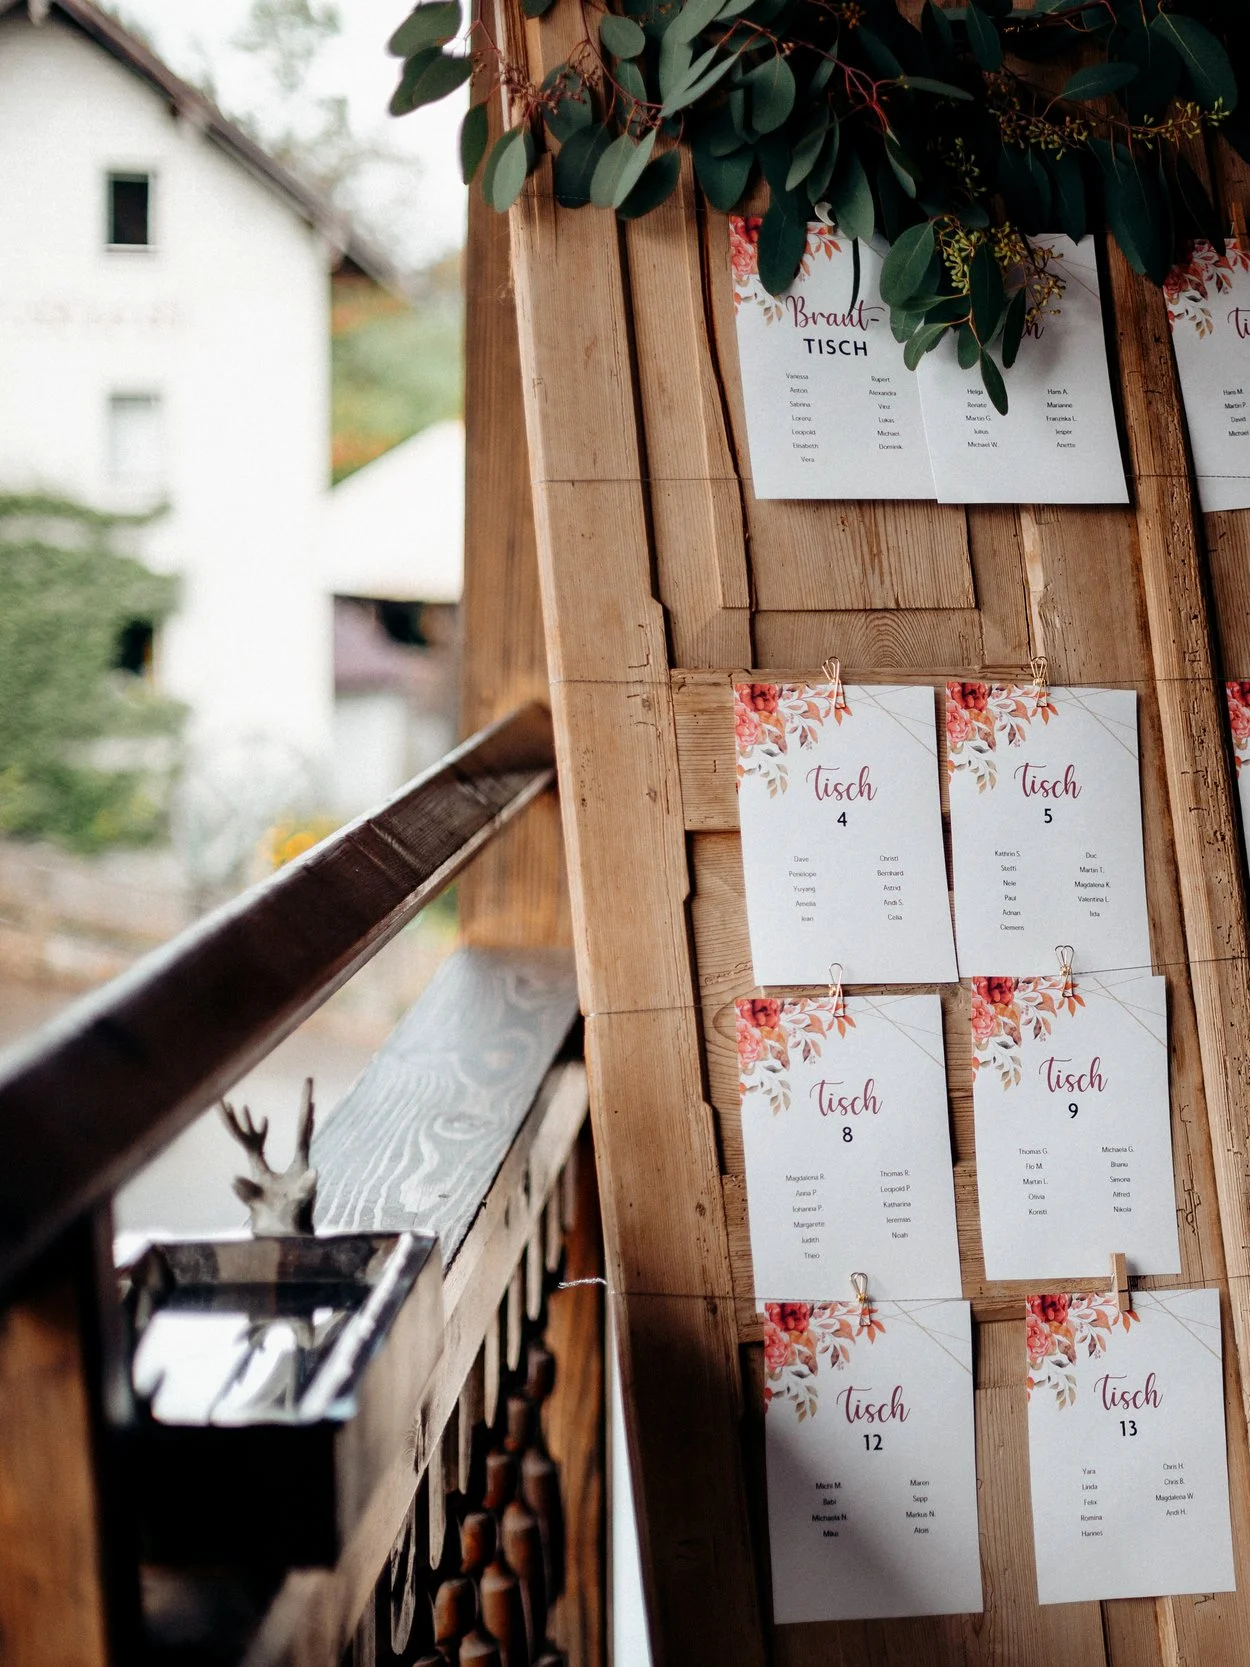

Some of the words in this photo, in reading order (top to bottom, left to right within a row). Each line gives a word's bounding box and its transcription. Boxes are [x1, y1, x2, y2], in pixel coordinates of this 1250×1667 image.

[785, 295, 886, 331] Braut-
[803, 338, 868, 356] TISCH
[806, 765, 877, 801] Tisch
[1014, 762, 1082, 798] Tisch
[837, 812, 847, 827] 4
[1044, 809, 1053, 823] 5
[1039, 1056, 1108, 1092] Tisch
[810, 1078, 883, 1116] Tisch
[1068, 1103, 1078, 1119] 9
[842, 1126, 853, 1143] 8
[836, 1385, 910, 1423] Tisch
[1094, 1372, 1163, 1410] Tisch
[1120, 1420, 1138, 1436] 13
[863, 1434, 883, 1450] 12
